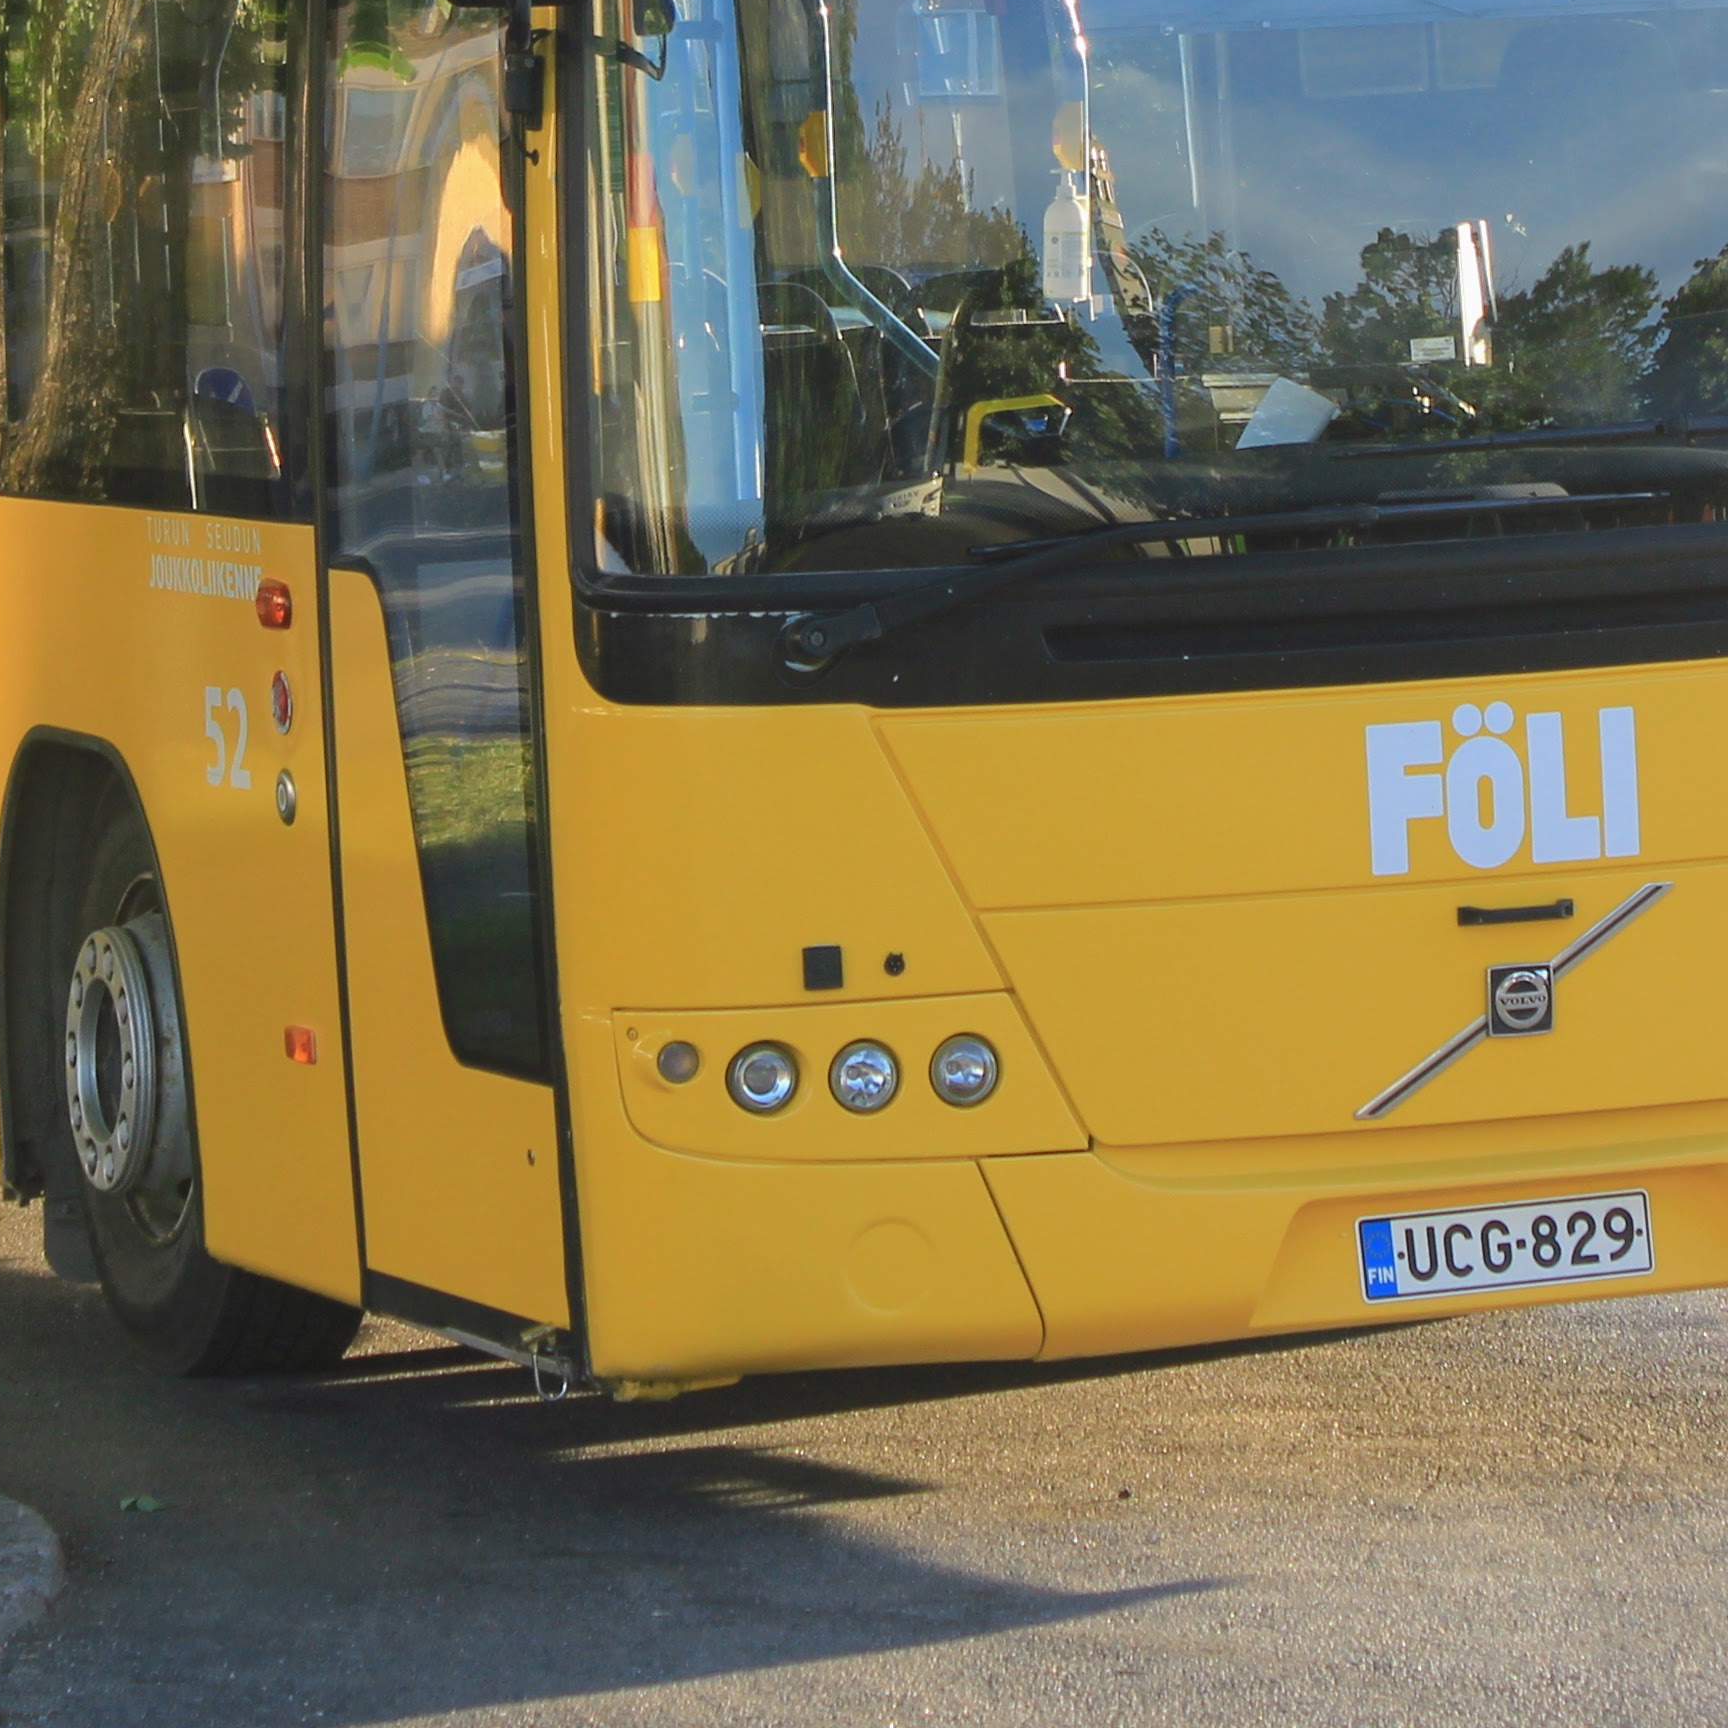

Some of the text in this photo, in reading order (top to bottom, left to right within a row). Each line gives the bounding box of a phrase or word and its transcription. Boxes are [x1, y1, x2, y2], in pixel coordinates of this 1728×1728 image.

[145, 516, 262, 555] TURUN SEUDUN
[149, 554, 262, 601] JOUKKOLIIKENNE
[204, 686, 252, 790] 52
[1365, 701, 1641, 876] FÖLI
[1499, 995, 1547, 1007] VOLVO
[1404, 1206, 1635, 1282] UCG-829
[1367, 1266, 1394, 1286] FIN
